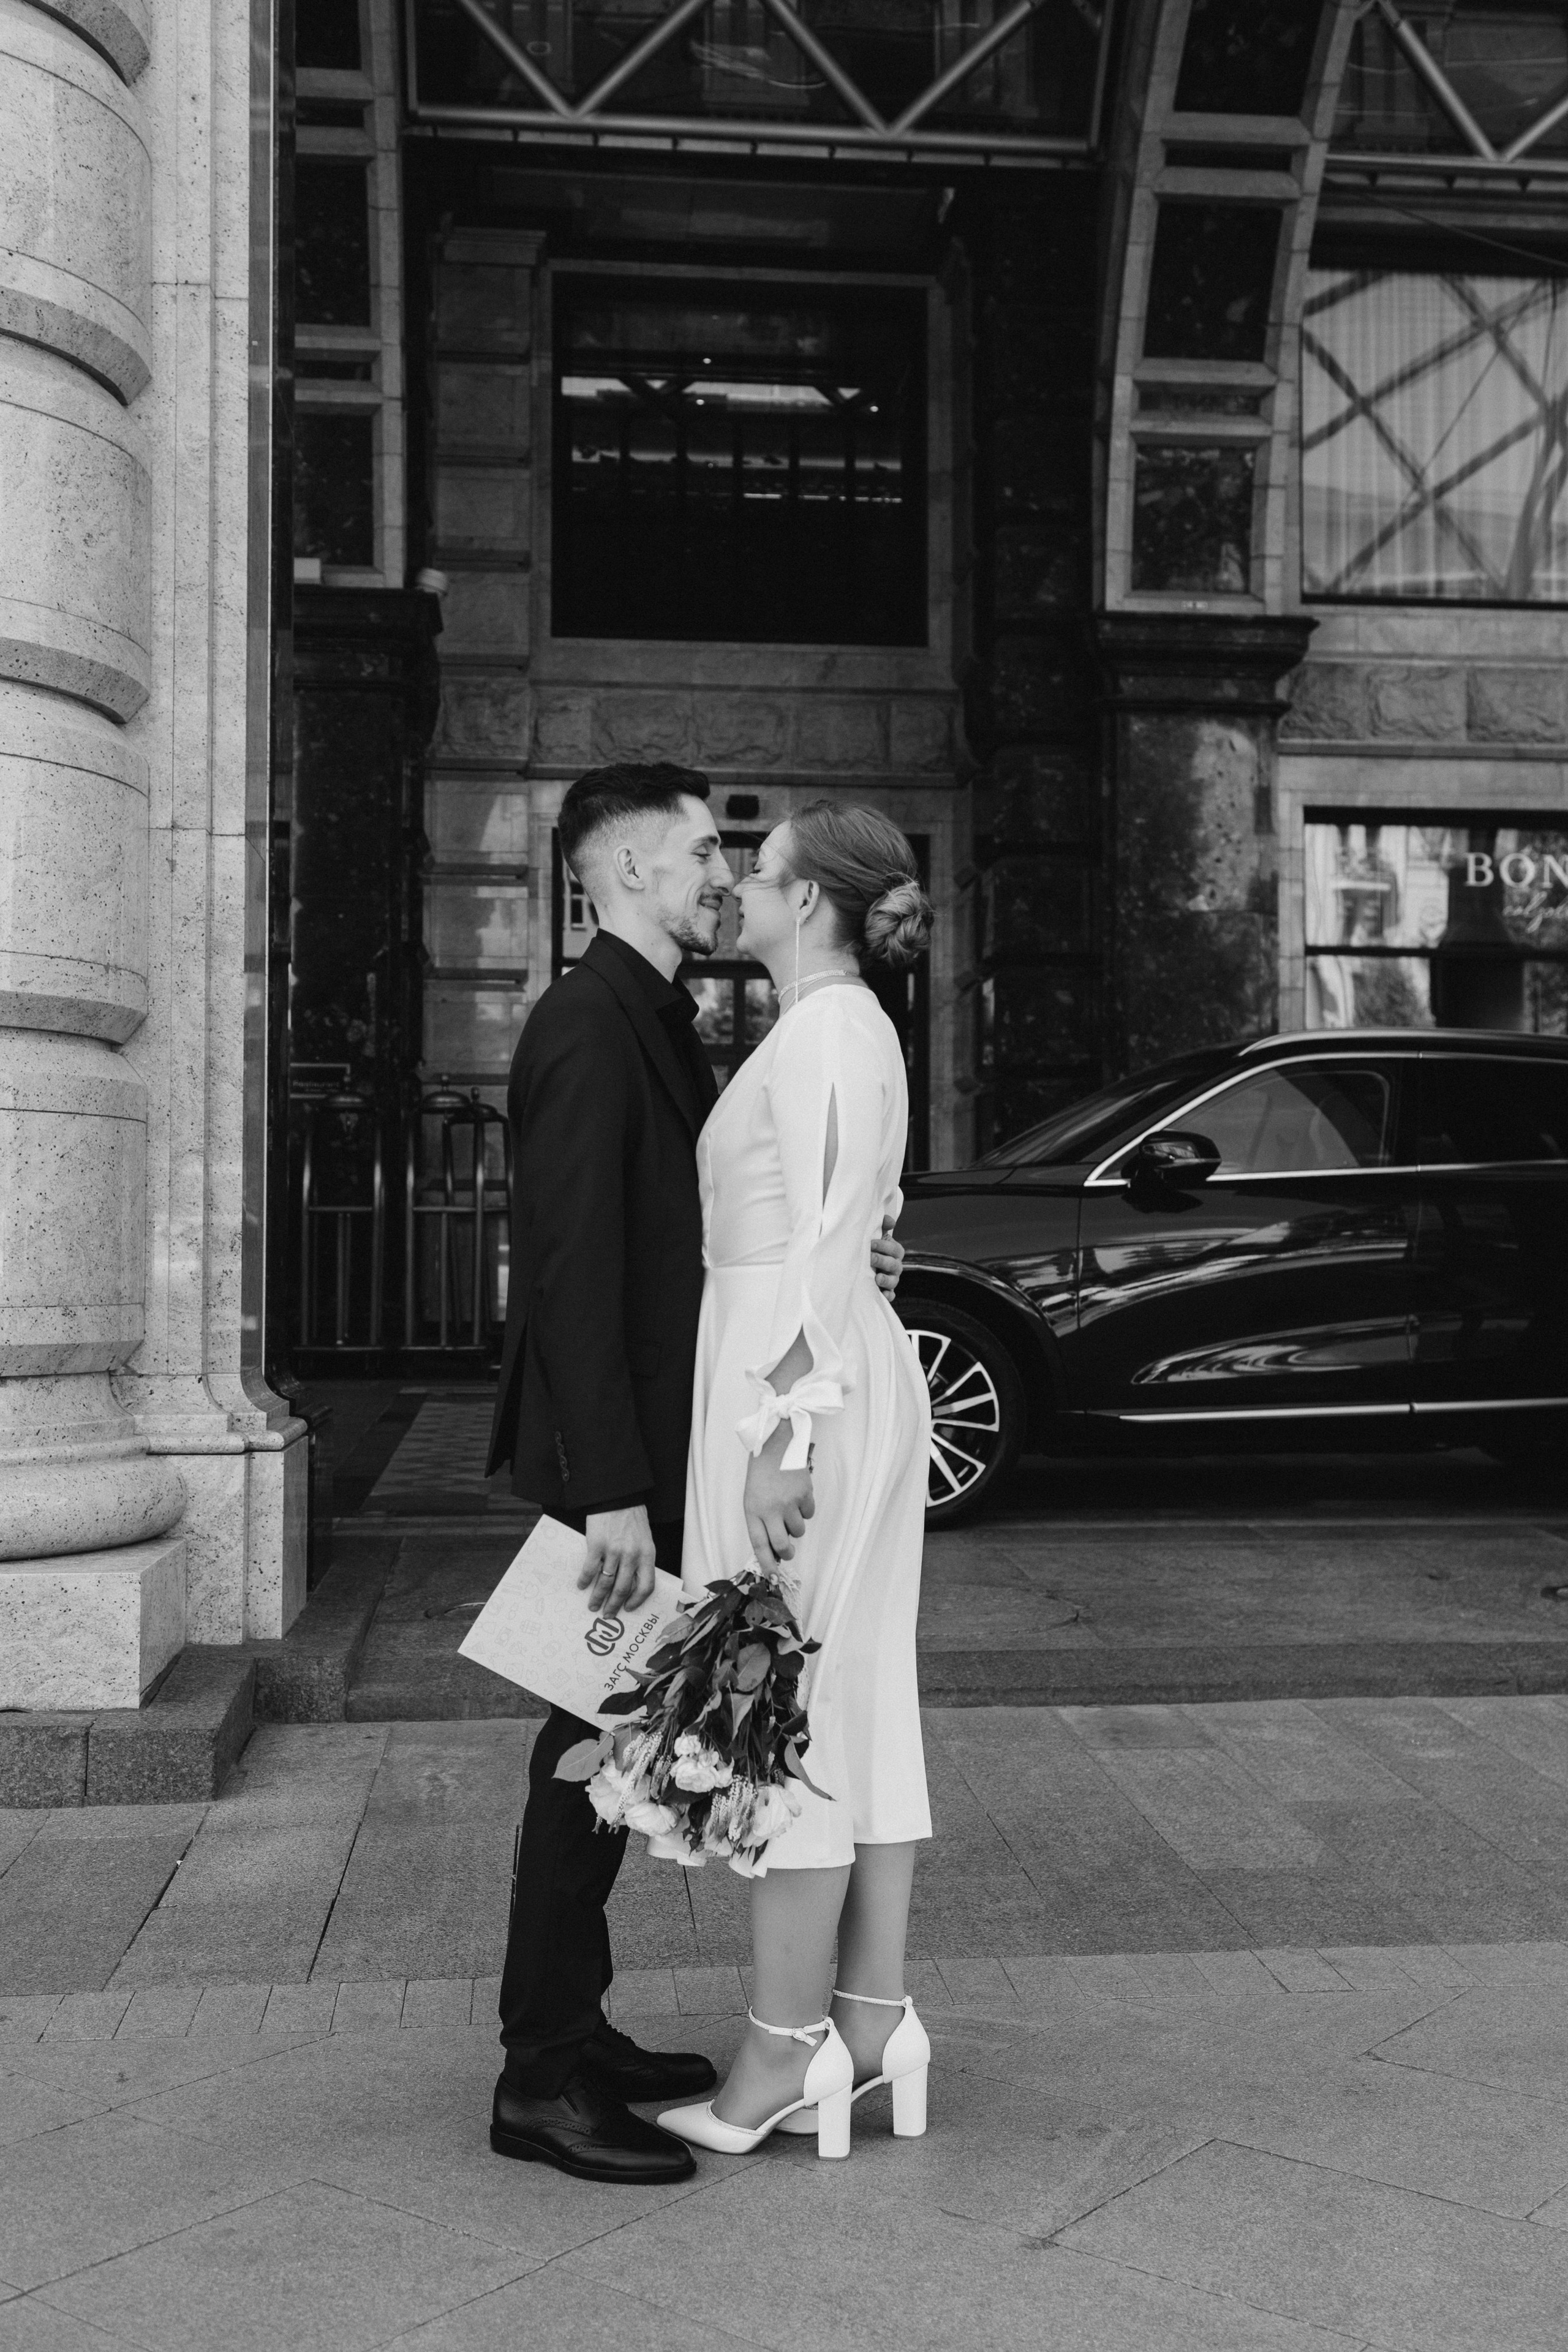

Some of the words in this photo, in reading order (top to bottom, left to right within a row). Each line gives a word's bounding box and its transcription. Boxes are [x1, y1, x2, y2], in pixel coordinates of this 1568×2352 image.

[1465, 851, 1568, 888] BON
[604, 1662, 627, 1691] ЗАГС
[622, 1613, 660, 1663] МОСКВЫ
